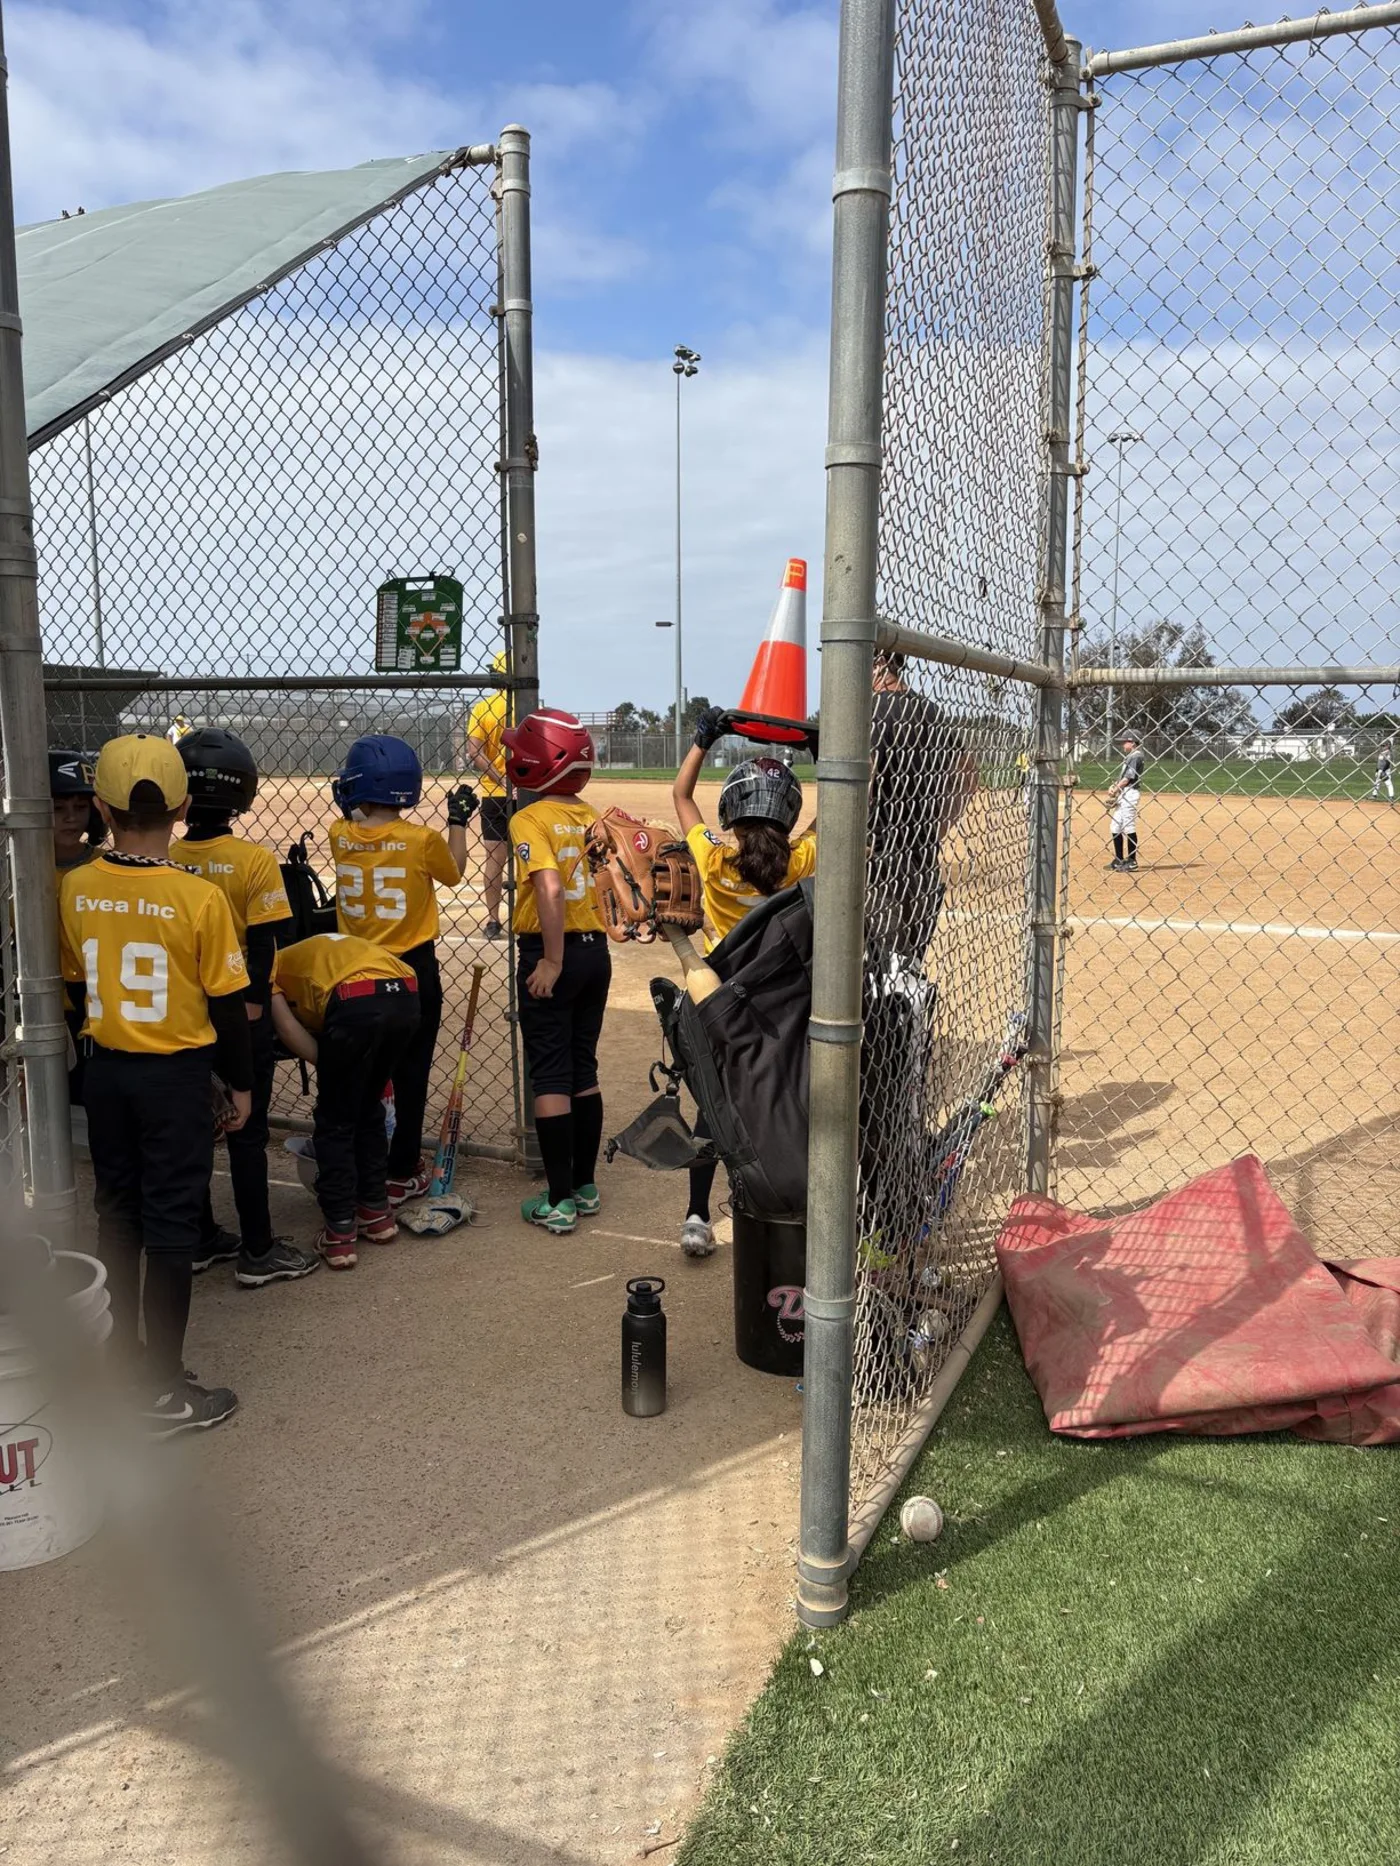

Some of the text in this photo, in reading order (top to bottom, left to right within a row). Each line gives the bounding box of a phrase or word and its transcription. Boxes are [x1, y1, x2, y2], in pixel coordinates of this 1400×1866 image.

[767, 768, 780, 778] 42
[338, 836, 407, 851] Evea Inc
[208, 861, 235, 874] Inc
[337, 863, 407, 919] 25
[75, 895, 176, 919] Evea Inc
[82, 938, 168, 1023] 19
